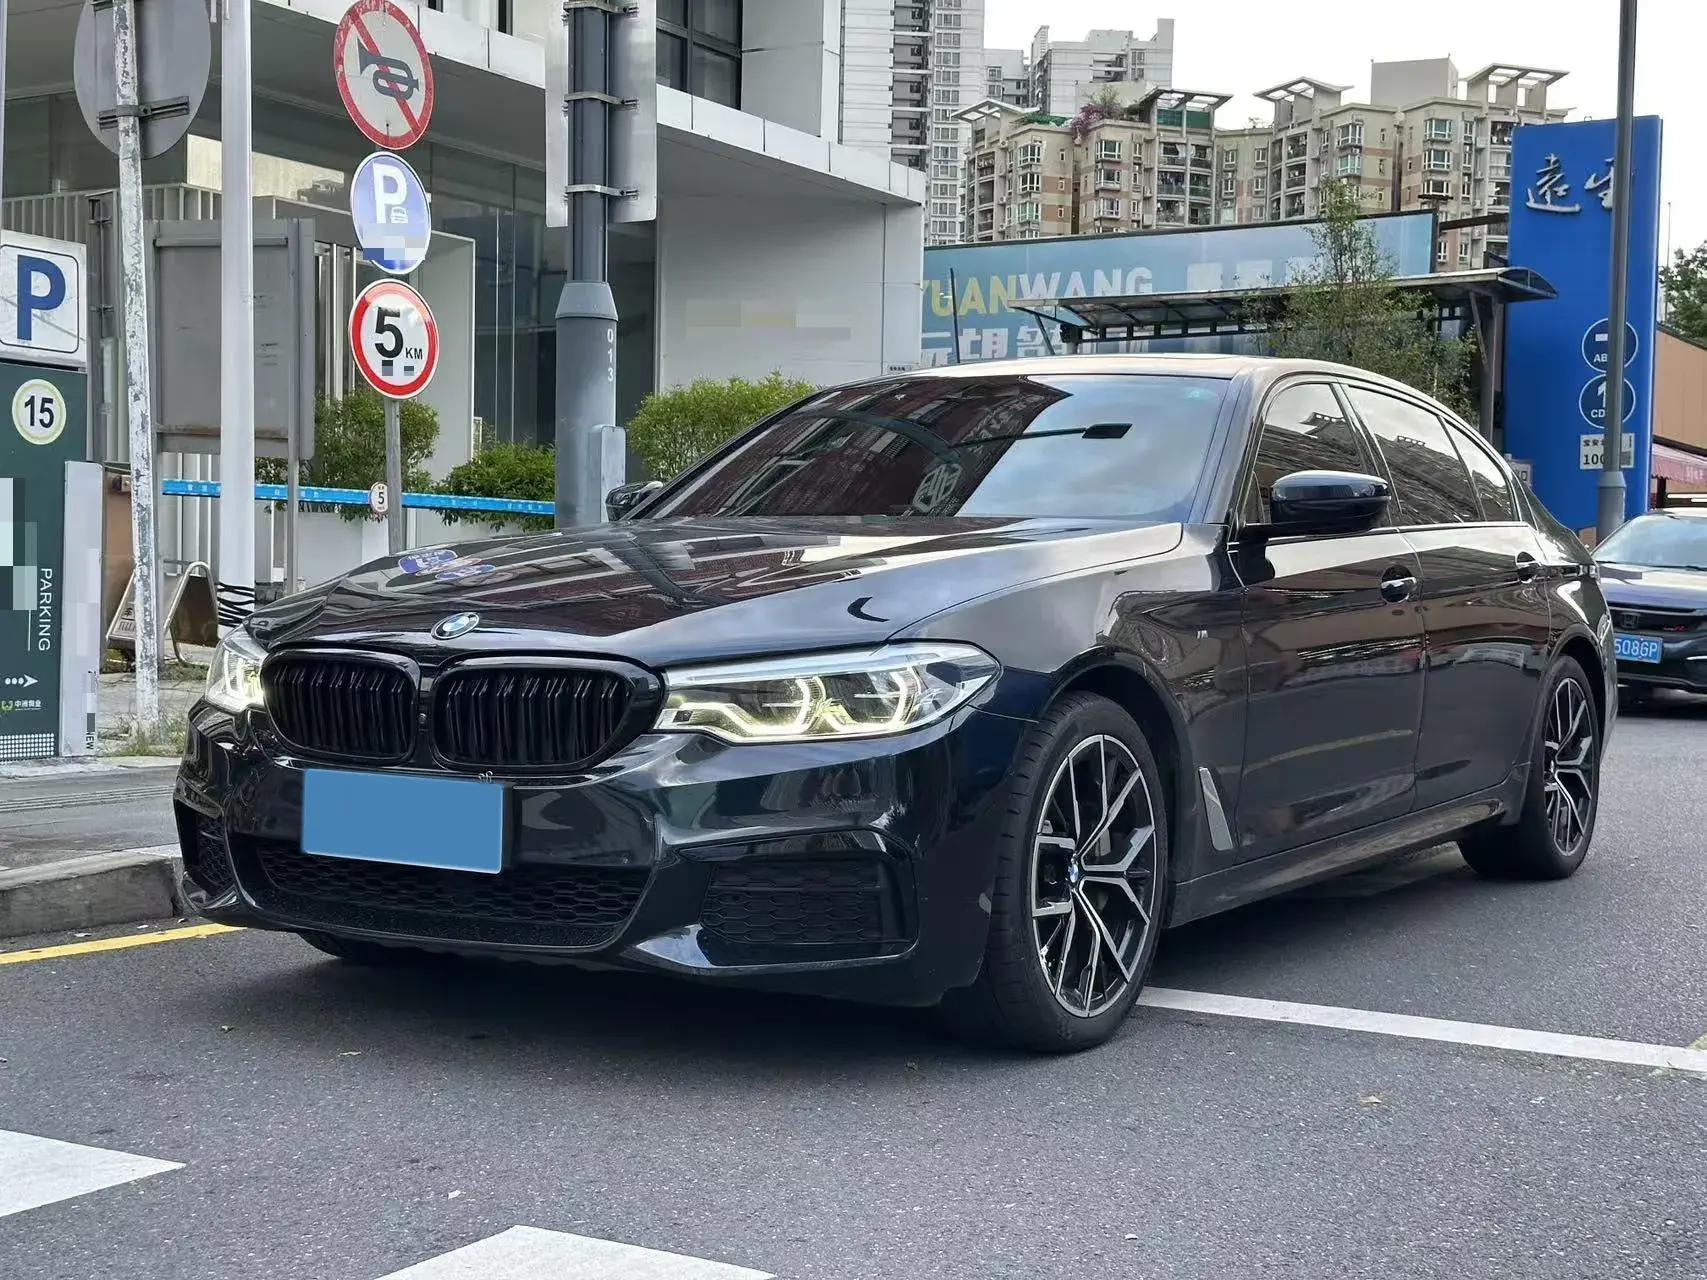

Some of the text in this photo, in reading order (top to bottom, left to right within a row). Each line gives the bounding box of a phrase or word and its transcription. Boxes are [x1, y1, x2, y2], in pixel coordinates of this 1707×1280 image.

[373, 162, 407, 223] P
[17, 254, 66, 341] P
[922, 267, 1153, 317] UANWANG
[374, 307, 423, 360] 5 KM
[24, 395, 54, 429] 15
[38, 568, 53, 651] PARKING
